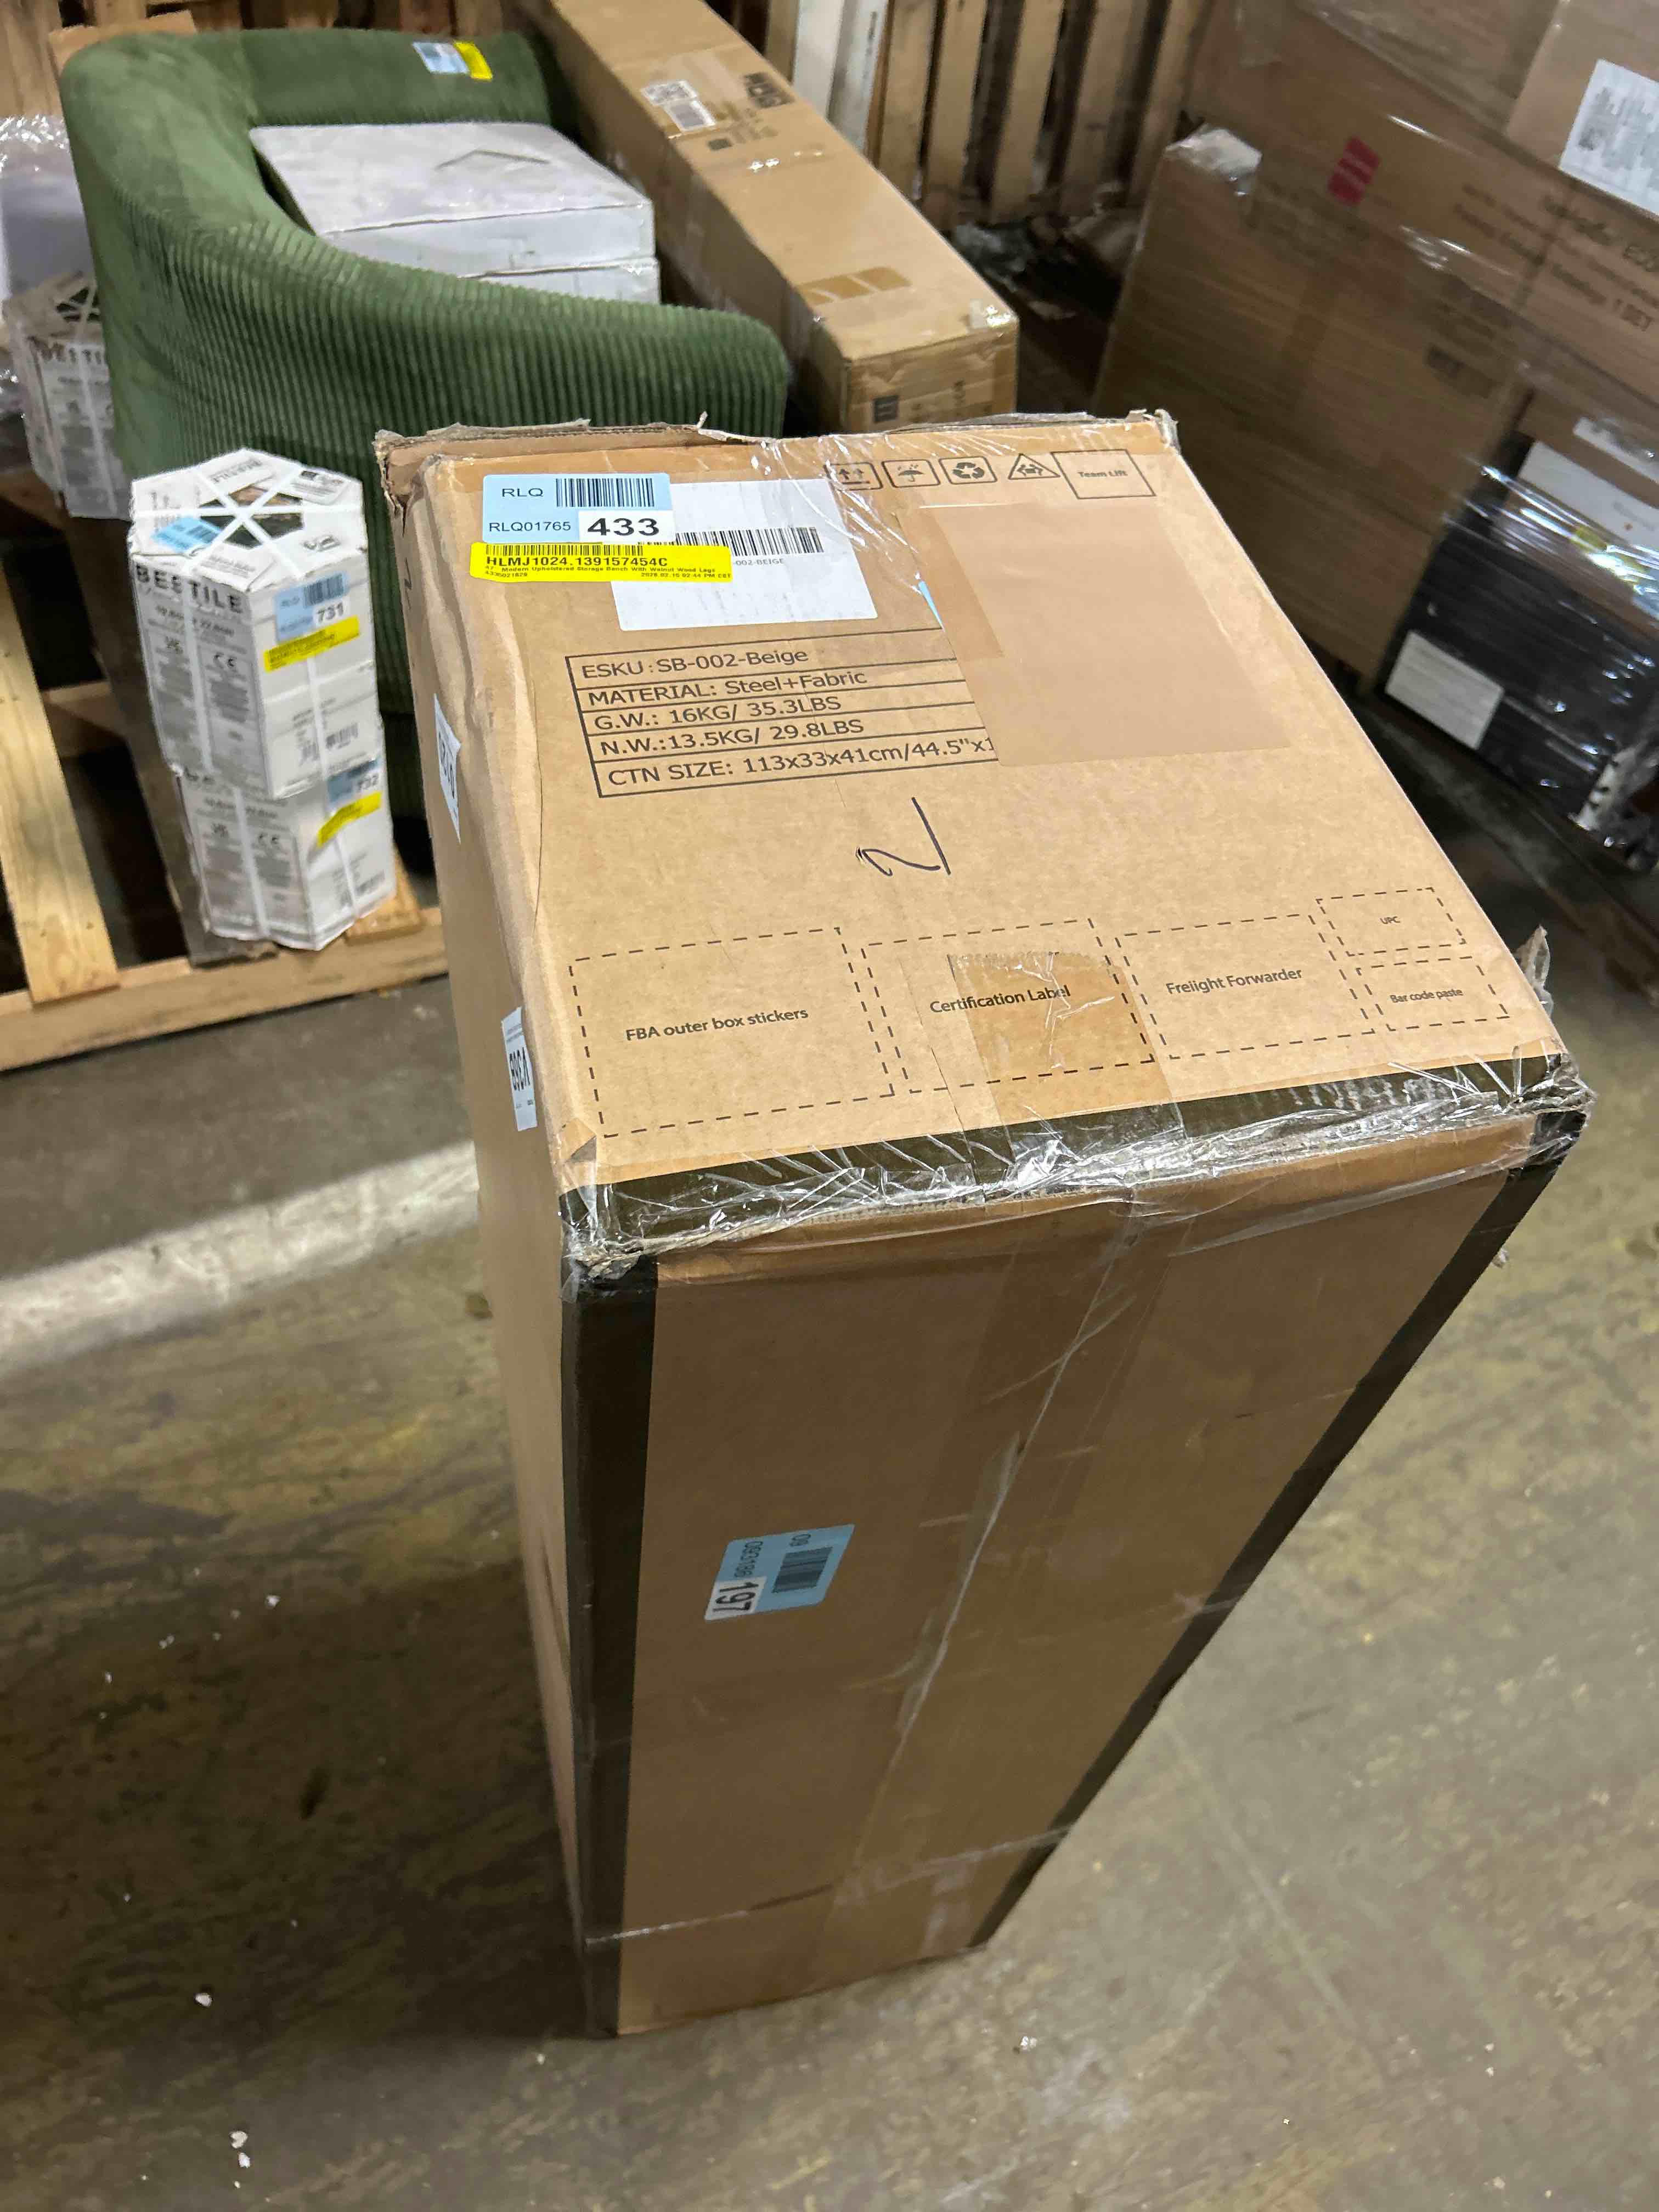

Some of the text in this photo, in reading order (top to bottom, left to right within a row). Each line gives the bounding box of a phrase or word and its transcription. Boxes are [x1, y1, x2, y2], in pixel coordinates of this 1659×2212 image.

[501, 488, 544, 498] RLQ
[489, 522, 571, 532] RLQ01765
[587, 517, 660, 537] 433
[486, 556, 668, 567] HLMJ1024.139157454C
[656, 650, 809, 673] SB-002-Beige
[589, 671, 867, 706] MATERIAL: Steel+Fabric
[594, 696, 842, 730] G.W.: 16KG/ 35.3LBS
[769, 719, 865, 740] 29.8LBS
[608, 767, 661, 786] CTN
[668, 760, 734, 780] SIZE:
[1380, 916, 1401, 924] UPC
[1165, 969, 1302, 994] Freiight Forwarder
[930, 984, 1071, 1013] Certification Label
[1390, 988, 1464, 1003] Bar code paste
[625, 1009, 809, 1041] FBA outer box stickers
[713, 1582, 759, 1611] 197
